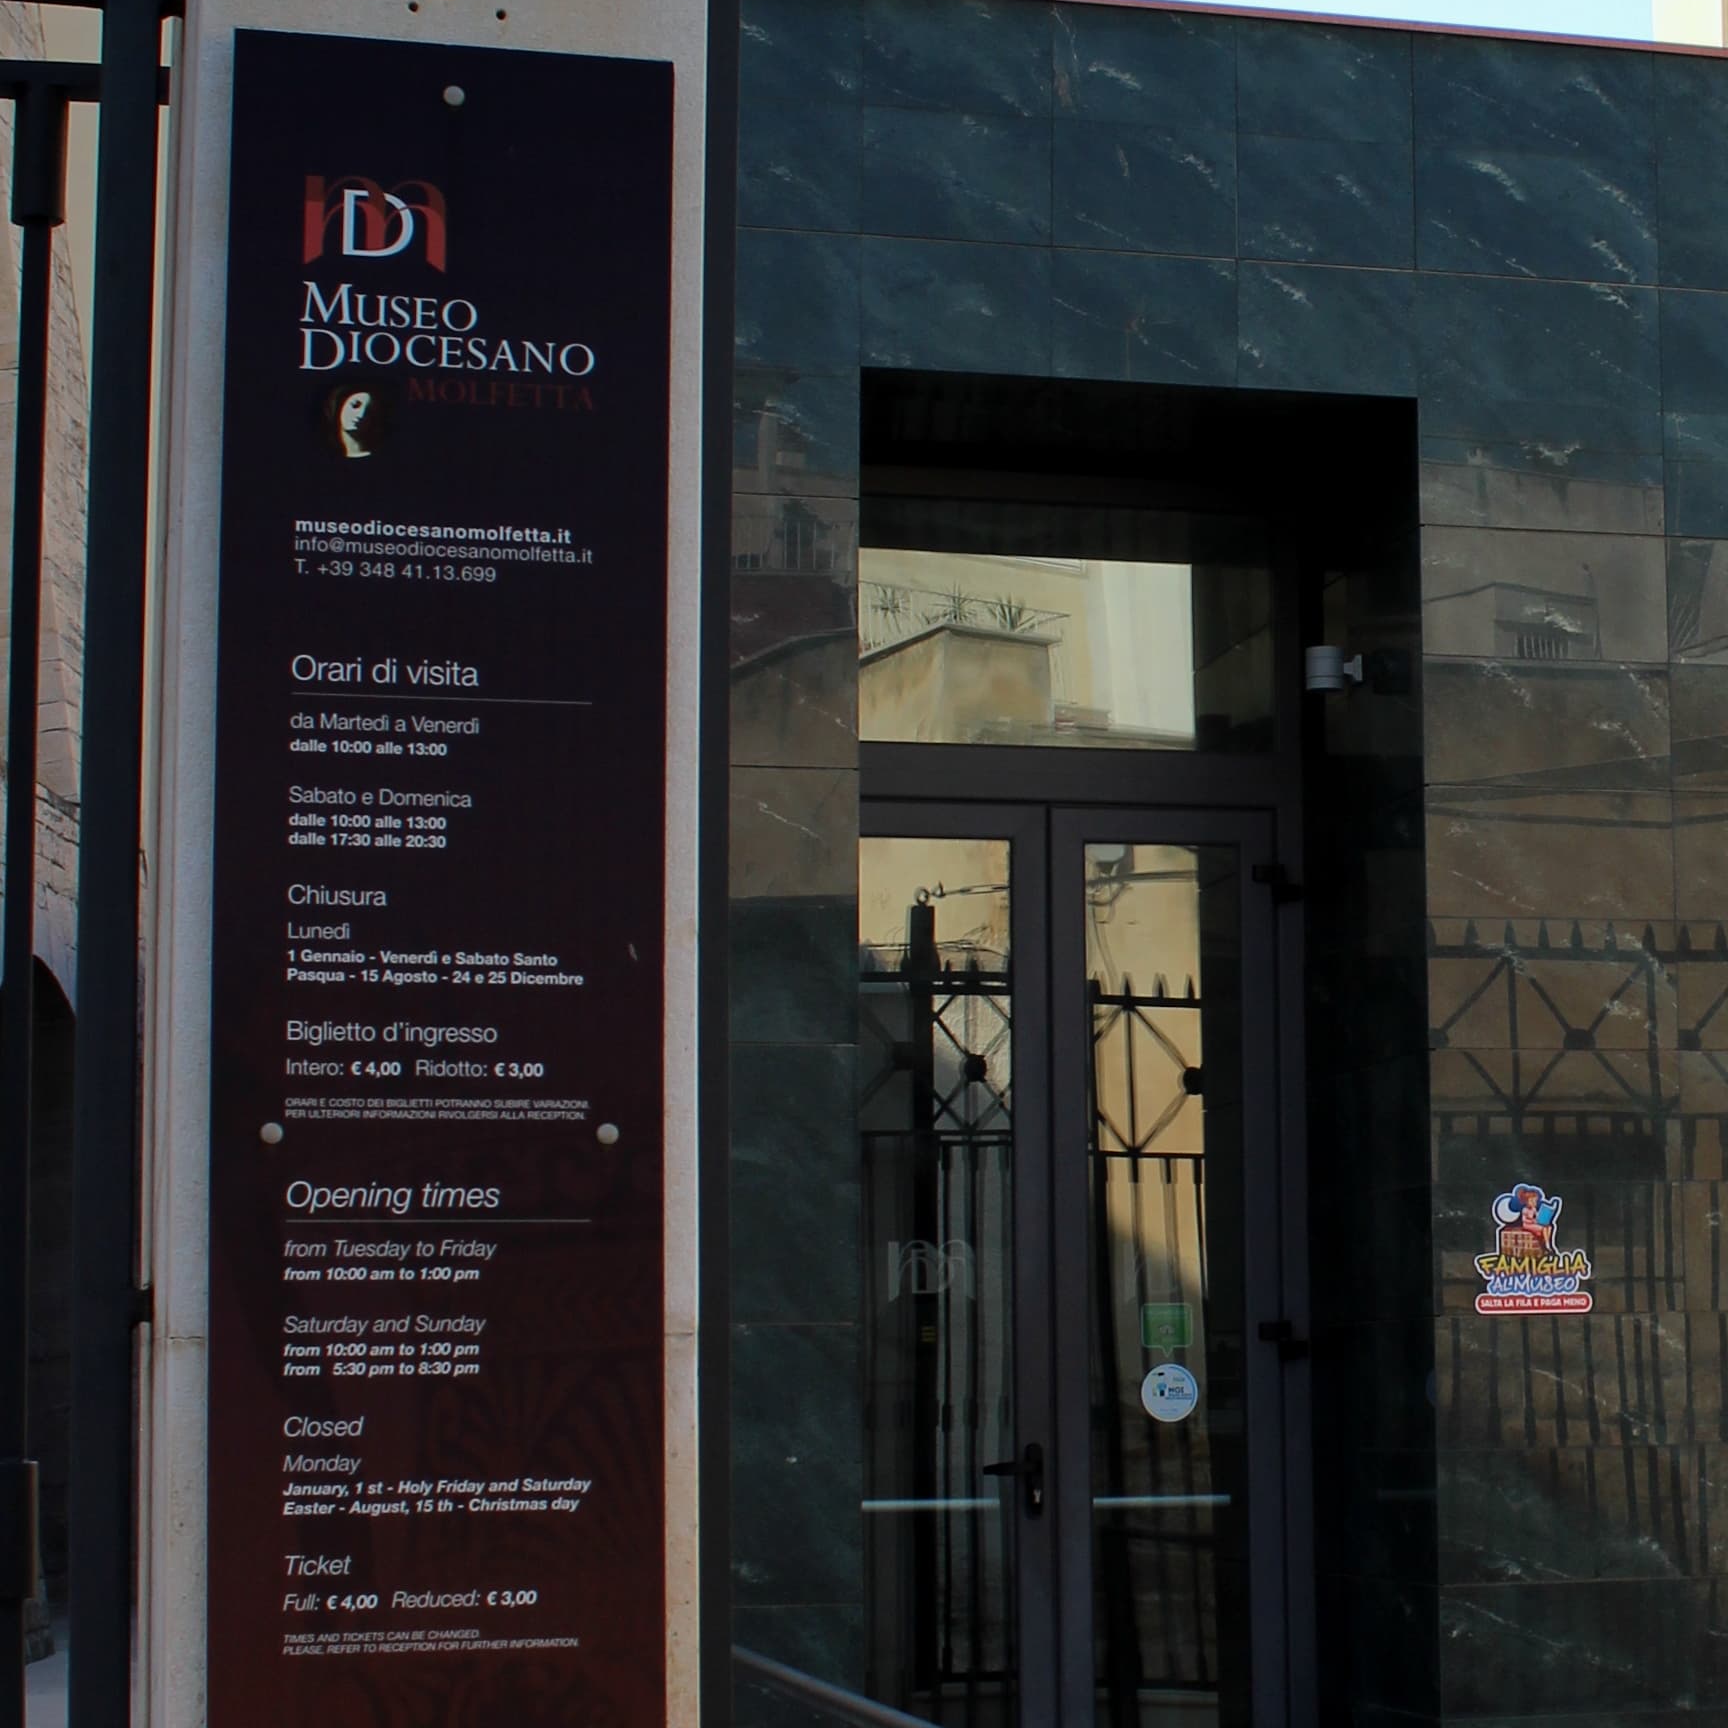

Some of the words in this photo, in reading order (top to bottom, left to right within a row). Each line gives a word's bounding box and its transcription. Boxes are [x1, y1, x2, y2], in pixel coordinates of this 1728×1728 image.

[300, 280, 477, 331] MUSEO
[299, 329, 595, 376] DIOCESANO
[409, 378, 593, 411] MOLFETTA
[296, 519, 571, 543] museodiocesanomolfetta.it
[295, 536, 592, 564] info@museodiocesanomolfetta.it
[294, 558, 308, 574] T.
[317, 560, 353, 576] +39
[359, 561, 394, 577] 348
[401, 563, 496, 582] 41.13.699
[291, 654, 361, 681] Orari
[371, 658, 396, 683] di
[406, 659, 478, 686] visita
[290, 712, 314, 728] da
[319, 712, 388, 731] Martedì
[394, 718, 406, 731] a
[411, 715, 479, 734] Venerdì
[289, 738, 327, 752] dalle
[331, 740, 371, 753] 10:00
[375, 741, 402, 754] alle
[407, 742, 447, 755] 13:00
[288, 785, 356, 804] Sabato
[361, 791, 373, 804] e
[379, 788, 471, 807] Domenica
[288, 831, 325, 845] dalle
[330, 832, 370, 846] 17:30
[374, 833, 401, 847] alle
[405, 834, 446, 848] 20:30
[287, 883, 386, 906] Chiusura
[287, 921, 349, 939] Lunedì
[287, 949, 294, 961] 1
[300, 948, 365, 963] Gennaio
[379, 950, 437, 964] Venerdì
[441, 954, 451, 964] e
[455, 951, 509, 965] Sabato
[513, 952, 557, 966] Santo
[287, 967, 344, 983] Pasqua
[361, 969, 378, 982] 15
[382, 969, 437, 985] Agosto
[452, 970, 470, 983] 24
[474, 973, 484, 983] e
[487, 970, 506, 984] 25
[510, 971, 583, 985] Dicembre
[286, 1020, 375, 1045] Biglietto
[382, 1021, 497, 1047] d'ingresso
[286, 1058, 343, 1075] Intero:
[415, 1059, 486, 1076] Ridotto:
[286, 1180, 412, 1214] Opening
[422, 1181, 500, 1207] times
[284, 1239, 326, 1257] from
[334, 1239, 411, 1260] Tuesday
[415, 1240, 434, 1256] to
[439, 1239, 496, 1260] Friday
[283, 1267, 320, 1280] from
[326, 1266, 367, 1280] 10:00
[369, 1270, 394, 1280] am
[399, 1267, 414, 1279] to
[420, 1266, 451, 1279] 1:00
[453, 1269, 479, 1282] pm
[1479, 1254, 1586, 1276] FAMIGLIA
[1480, 1299, 1502, 1308] SALTA
[1504, 1299, 1514, 1307] LA
[1516, 1298, 1532, 1307] FILA
[283, 1315, 368, 1336] Saturday
[372, 1315, 410, 1332] and
[414, 1314, 486, 1335] Sunday
[283, 1362, 320, 1375] from
[332, 1362, 366, 1375] 5:30
[367, 1364, 394, 1377] pm
[398, 1362, 414, 1374] to
[417, 1361, 451, 1374] 8:30
[452, 1363, 479, 1376] pm
[283, 1415, 364, 1437] Closed
[282, 1454, 361, 1474] Monday
[282, 1482, 348, 1497] January,
[355, 1482, 362, 1494] 1
[367, 1481, 382, 1494] st
[397, 1480, 433, 1496] Holy
[436, 1479, 485, 1495] Friday
[488, 1478, 518, 1491] and
[521, 1477, 591, 1492] Saturday
[282, 1501, 335, 1515] Easter
[348, 1500, 409, 1516] August,
[416, 1499, 433, 1512] 15
[437, 1498, 453, 1512] th
[468, 1497, 547, 1511] Christmas
[551, 1496, 579, 1512] day
[284, 1555, 351, 1575] Ticket
[282, 1593, 320, 1611] Full:
[391, 1589, 480, 1608] Reduced:
